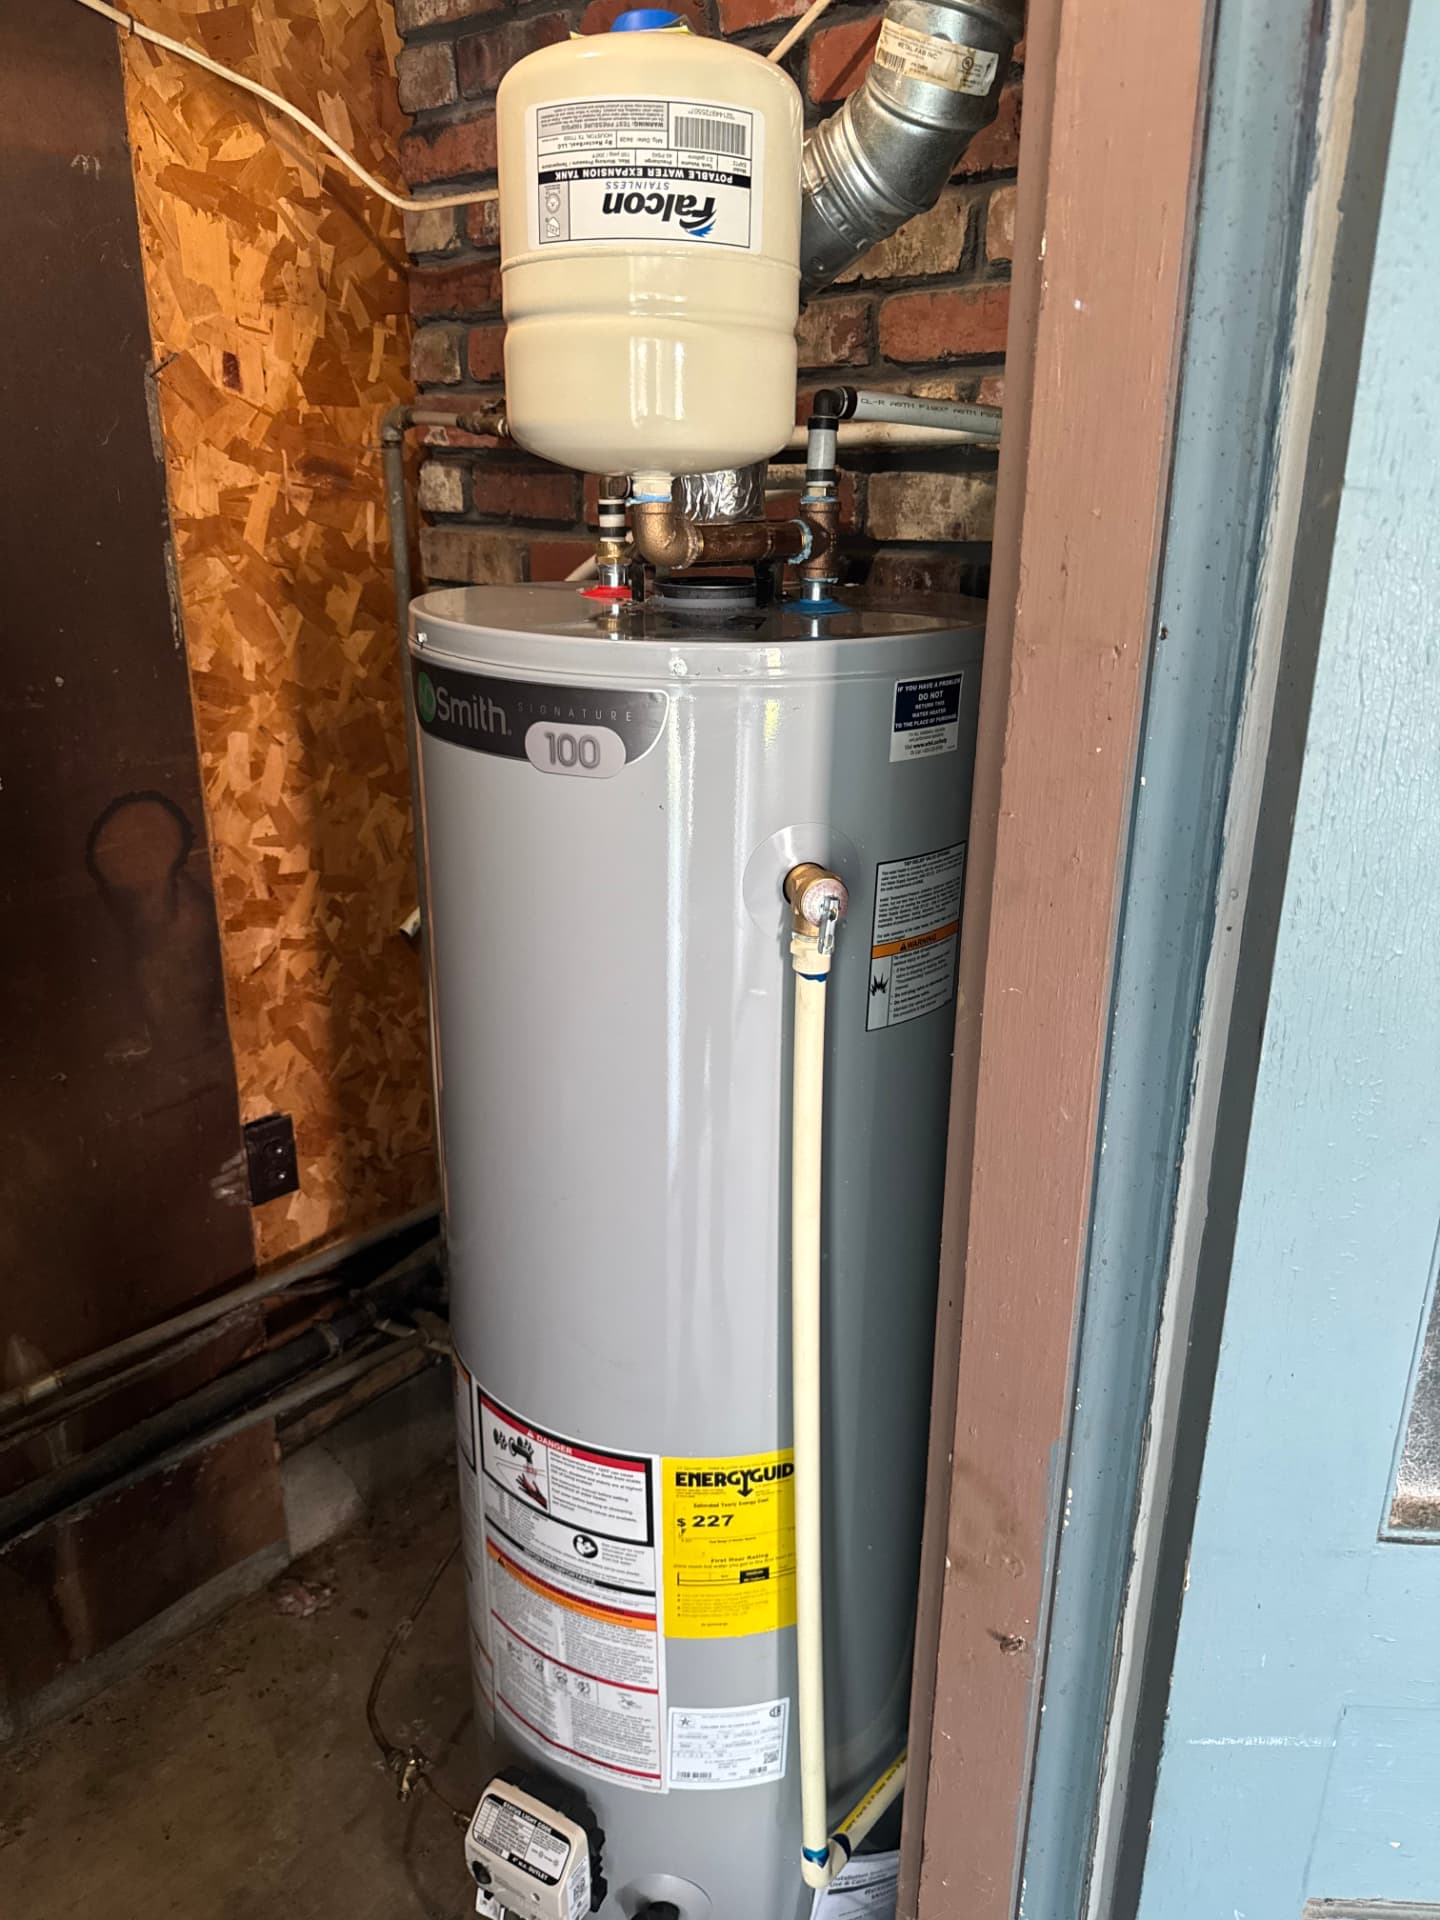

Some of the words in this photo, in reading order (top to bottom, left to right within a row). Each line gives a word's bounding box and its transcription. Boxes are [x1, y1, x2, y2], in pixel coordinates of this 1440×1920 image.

[554, 171, 579, 180] TANK
[582, 167, 643, 179] EXPANSION
[646, 168, 684, 181] WATER
[688, 170, 733, 184] POTABLE
[604, 181, 670, 191] STAINLESS
[602, 192, 717, 231] Falcon
[918, 693, 928, 701] DO
[930, 690, 944, 699] NOT
[517, 701, 633, 723] SIGNATURE
[544, 731, 601, 770] 100
[536, 1435, 573, 1455] DANGER
[675, 1463, 795, 1493] ENERGYGUID
[676, 1518, 686, 1527] $
[692, 1514, 734, 1527] 227
